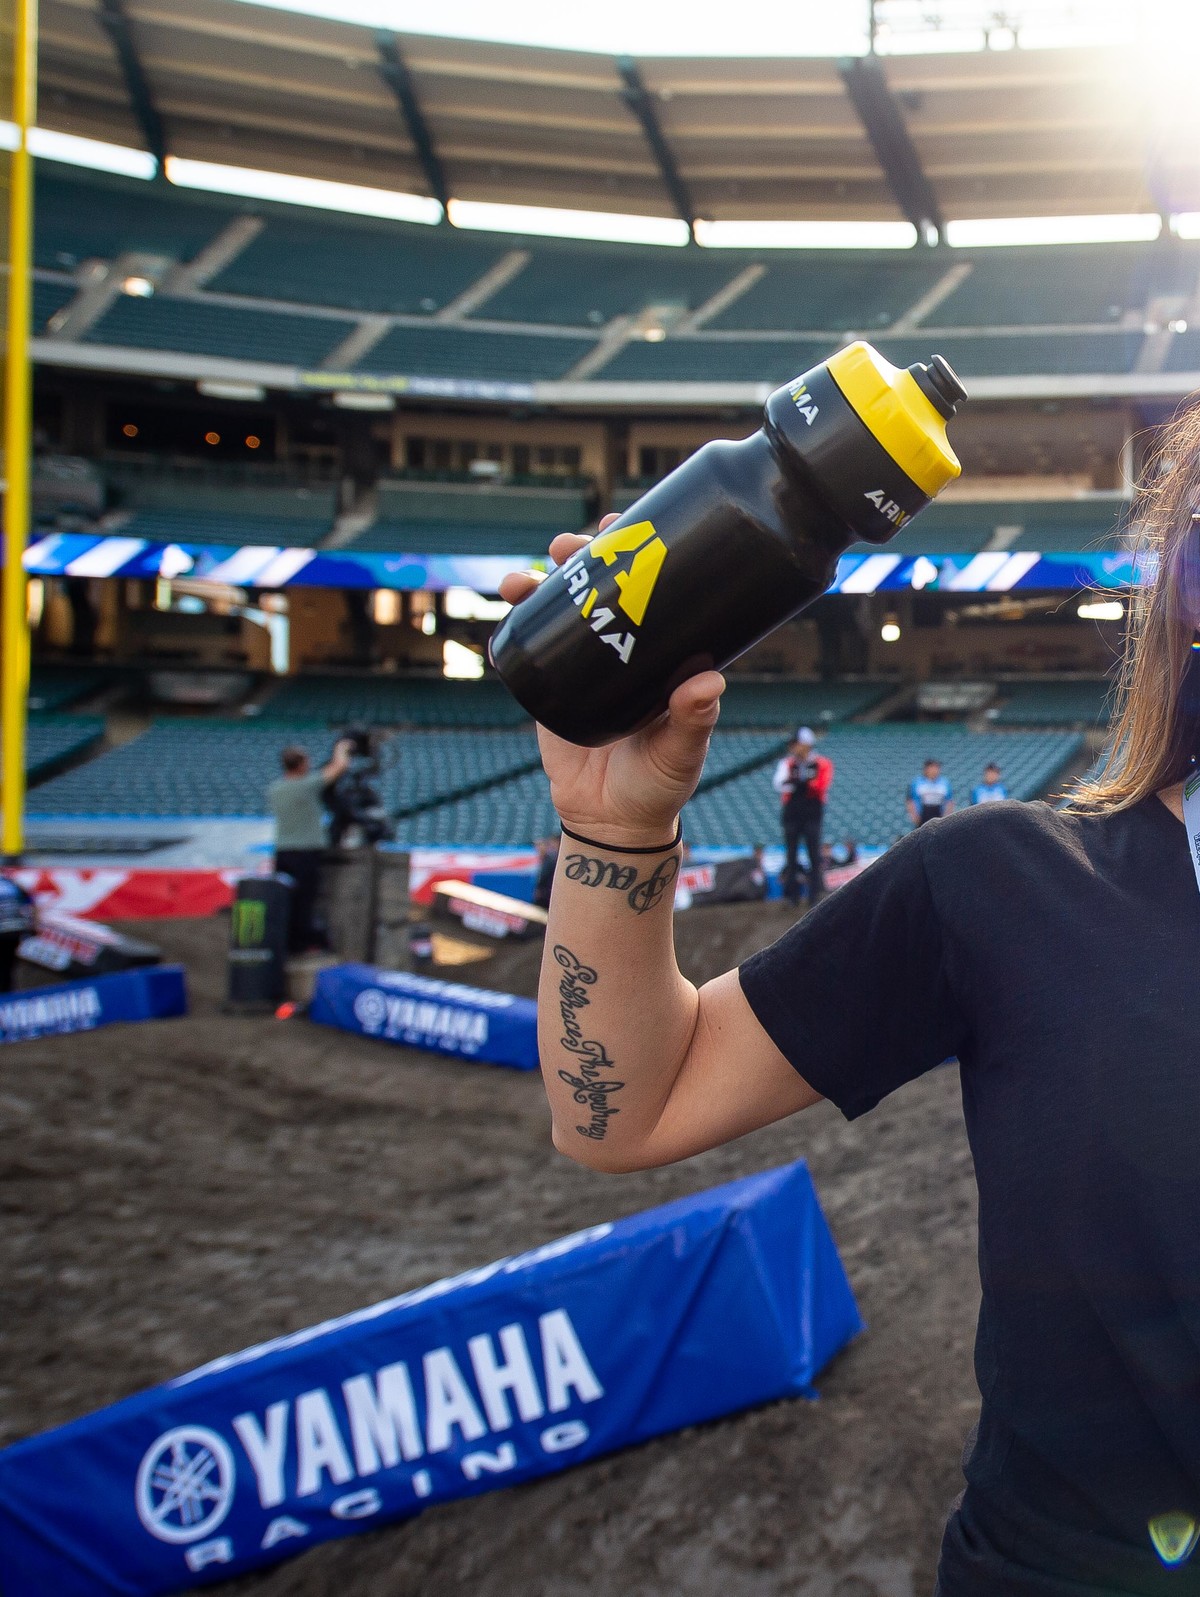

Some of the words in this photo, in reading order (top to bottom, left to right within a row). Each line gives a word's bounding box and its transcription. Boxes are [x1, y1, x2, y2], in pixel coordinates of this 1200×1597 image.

[864, 489, 911, 527] ARM
[386, 994, 489, 1046] YAMAHA
[562, 1038, 614, 1083] The
[558, 1069, 626, 1140] Journey
[232, 1307, 605, 1511] YAMAHA
[184, 1420, 591, 1573] RACING
